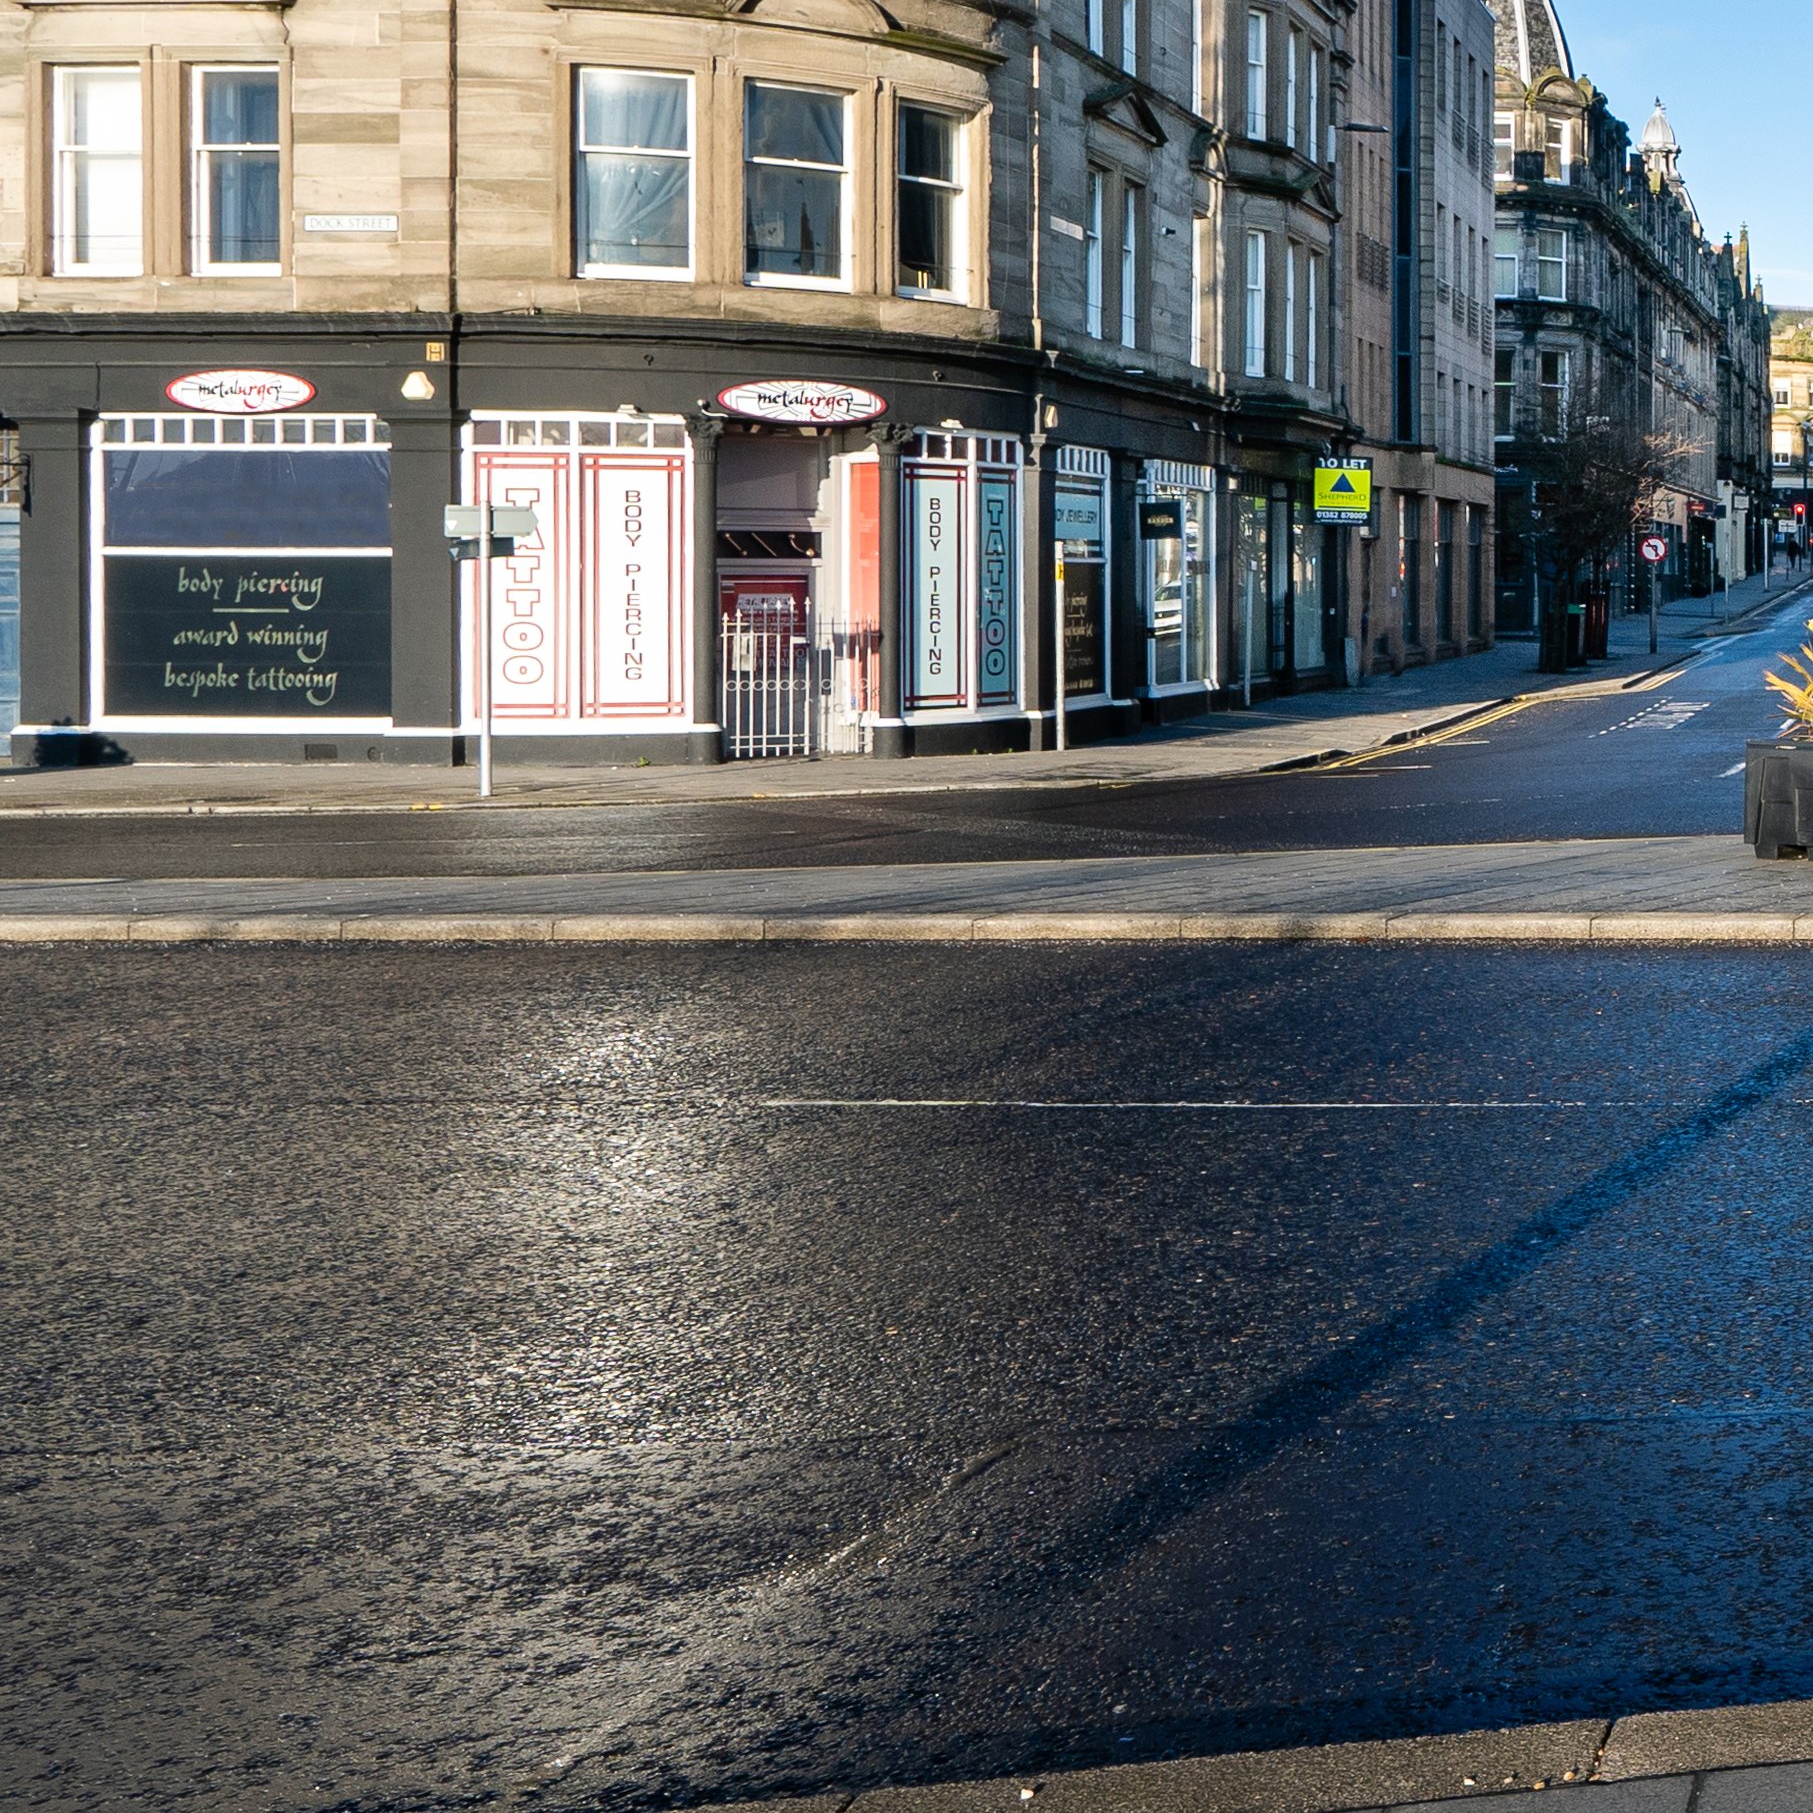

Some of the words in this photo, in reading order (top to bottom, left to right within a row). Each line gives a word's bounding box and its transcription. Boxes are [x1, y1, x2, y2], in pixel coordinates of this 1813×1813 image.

[1342, 458, 1367, 469] LET
[625, 490, 642, 547] BODY
[929, 497, 942, 552] BODY
[177, 566, 224, 600] body
[234, 571, 324, 611] piercing
[985, 499, 1006, 676] TATTOO
[173, 620, 239, 646] award
[246, 624, 329, 663] winning
[624, 564, 643, 681] PIERCING
[929, 566, 942, 675] PIERCING
[164, 661, 240, 698] bespoke
[246, 667, 338, 706] tattooing
